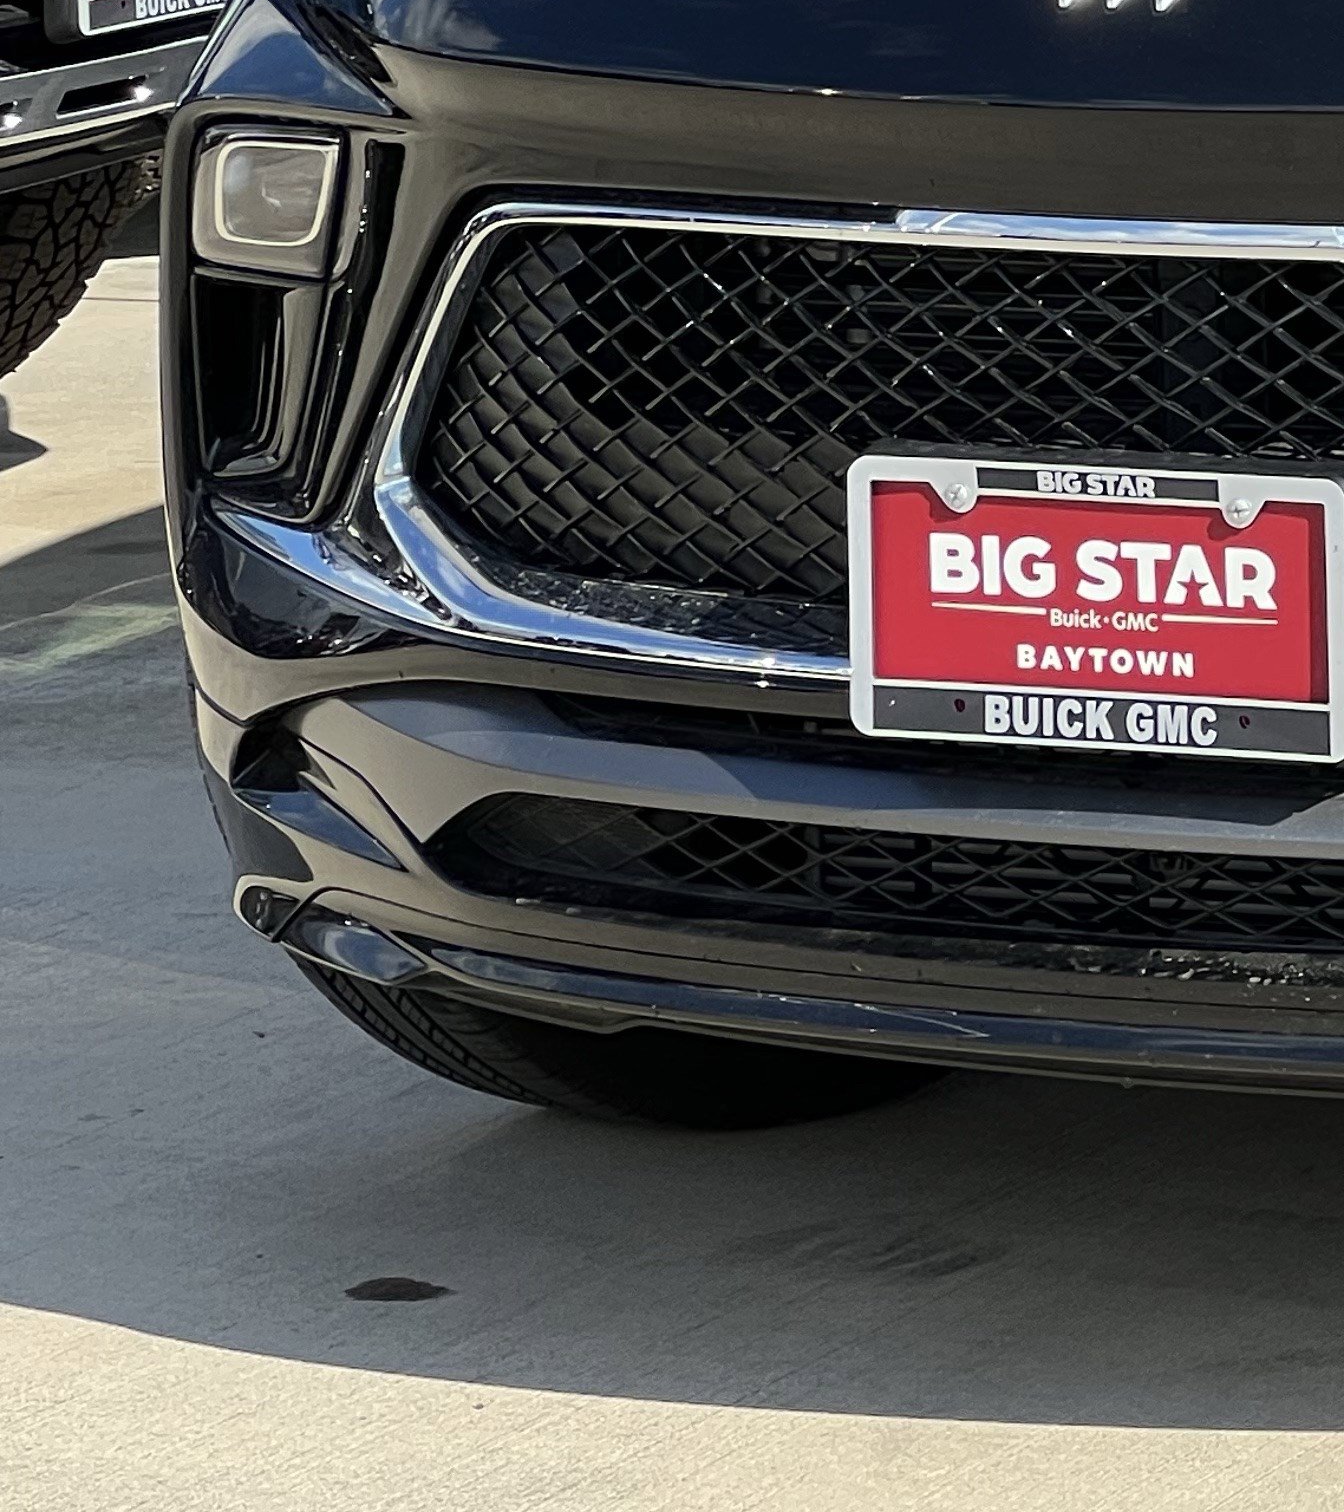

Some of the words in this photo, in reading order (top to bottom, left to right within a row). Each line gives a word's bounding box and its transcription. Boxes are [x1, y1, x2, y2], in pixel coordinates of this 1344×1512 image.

[1036, 470, 1082, 494] BIG
[1086, 473, 1156, 498] STAR
[929, 532, 1057, 599] BIG
[1076, 539, 1278, 610] STAR
[1050, 608, 1102, 630] Buick
[1111, 611, 1159, 633] GMC
[1016, 643, 1195, 679] BAYTOWN
[984, 694, 1115, 740] BUICK
[1126, 702, 1218, 747] GMC
